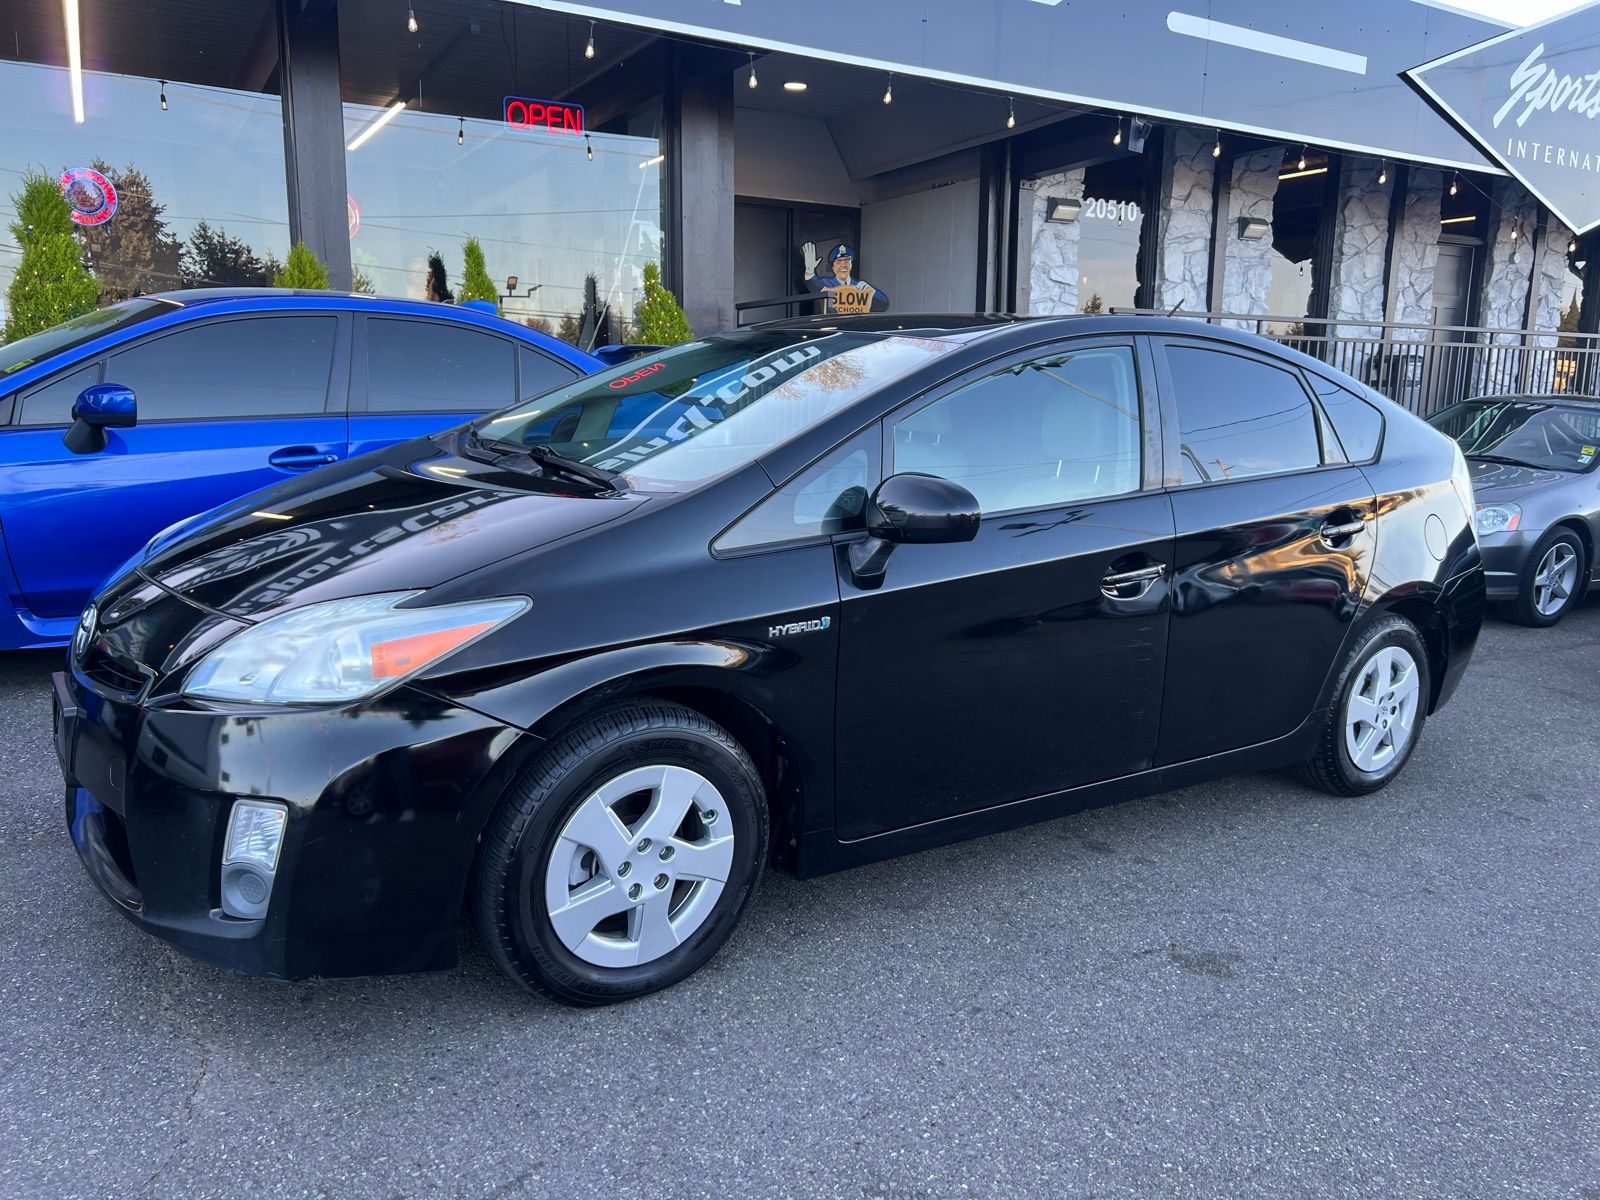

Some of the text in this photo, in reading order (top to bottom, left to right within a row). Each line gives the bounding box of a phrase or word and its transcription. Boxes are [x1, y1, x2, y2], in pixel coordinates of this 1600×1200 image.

[507, 101, 581, 136] OPEN
[1085, 197, 1137, 222] 20510
[769, 620, 821, 637] HYBRID
